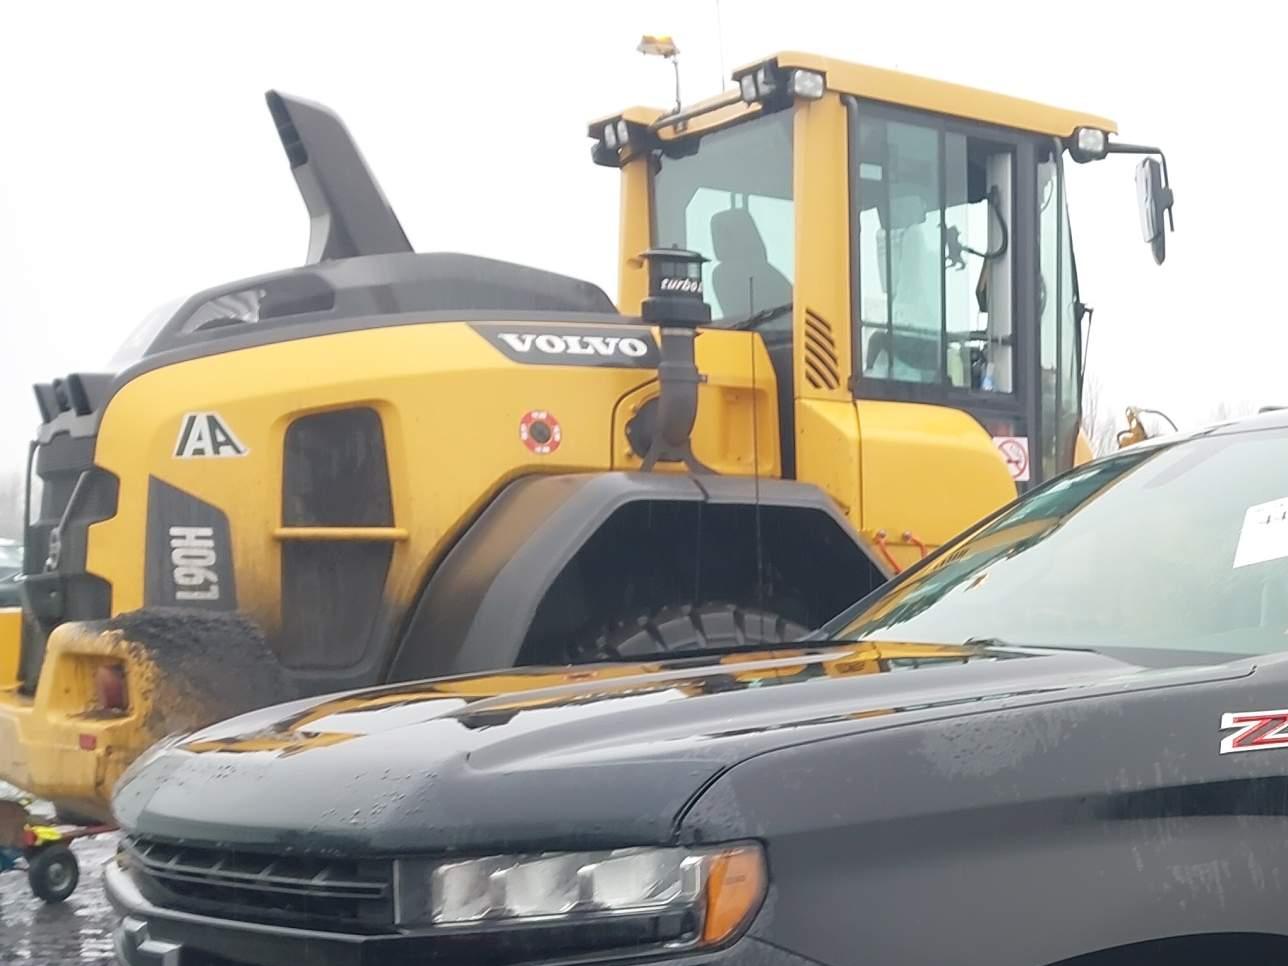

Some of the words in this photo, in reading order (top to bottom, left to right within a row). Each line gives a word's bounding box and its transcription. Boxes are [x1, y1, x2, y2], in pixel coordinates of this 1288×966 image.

[498, 333, 648, 358] VOLVO
[174, 413, 245, 457] IAA
[169, 526, 220, 600] L90H
